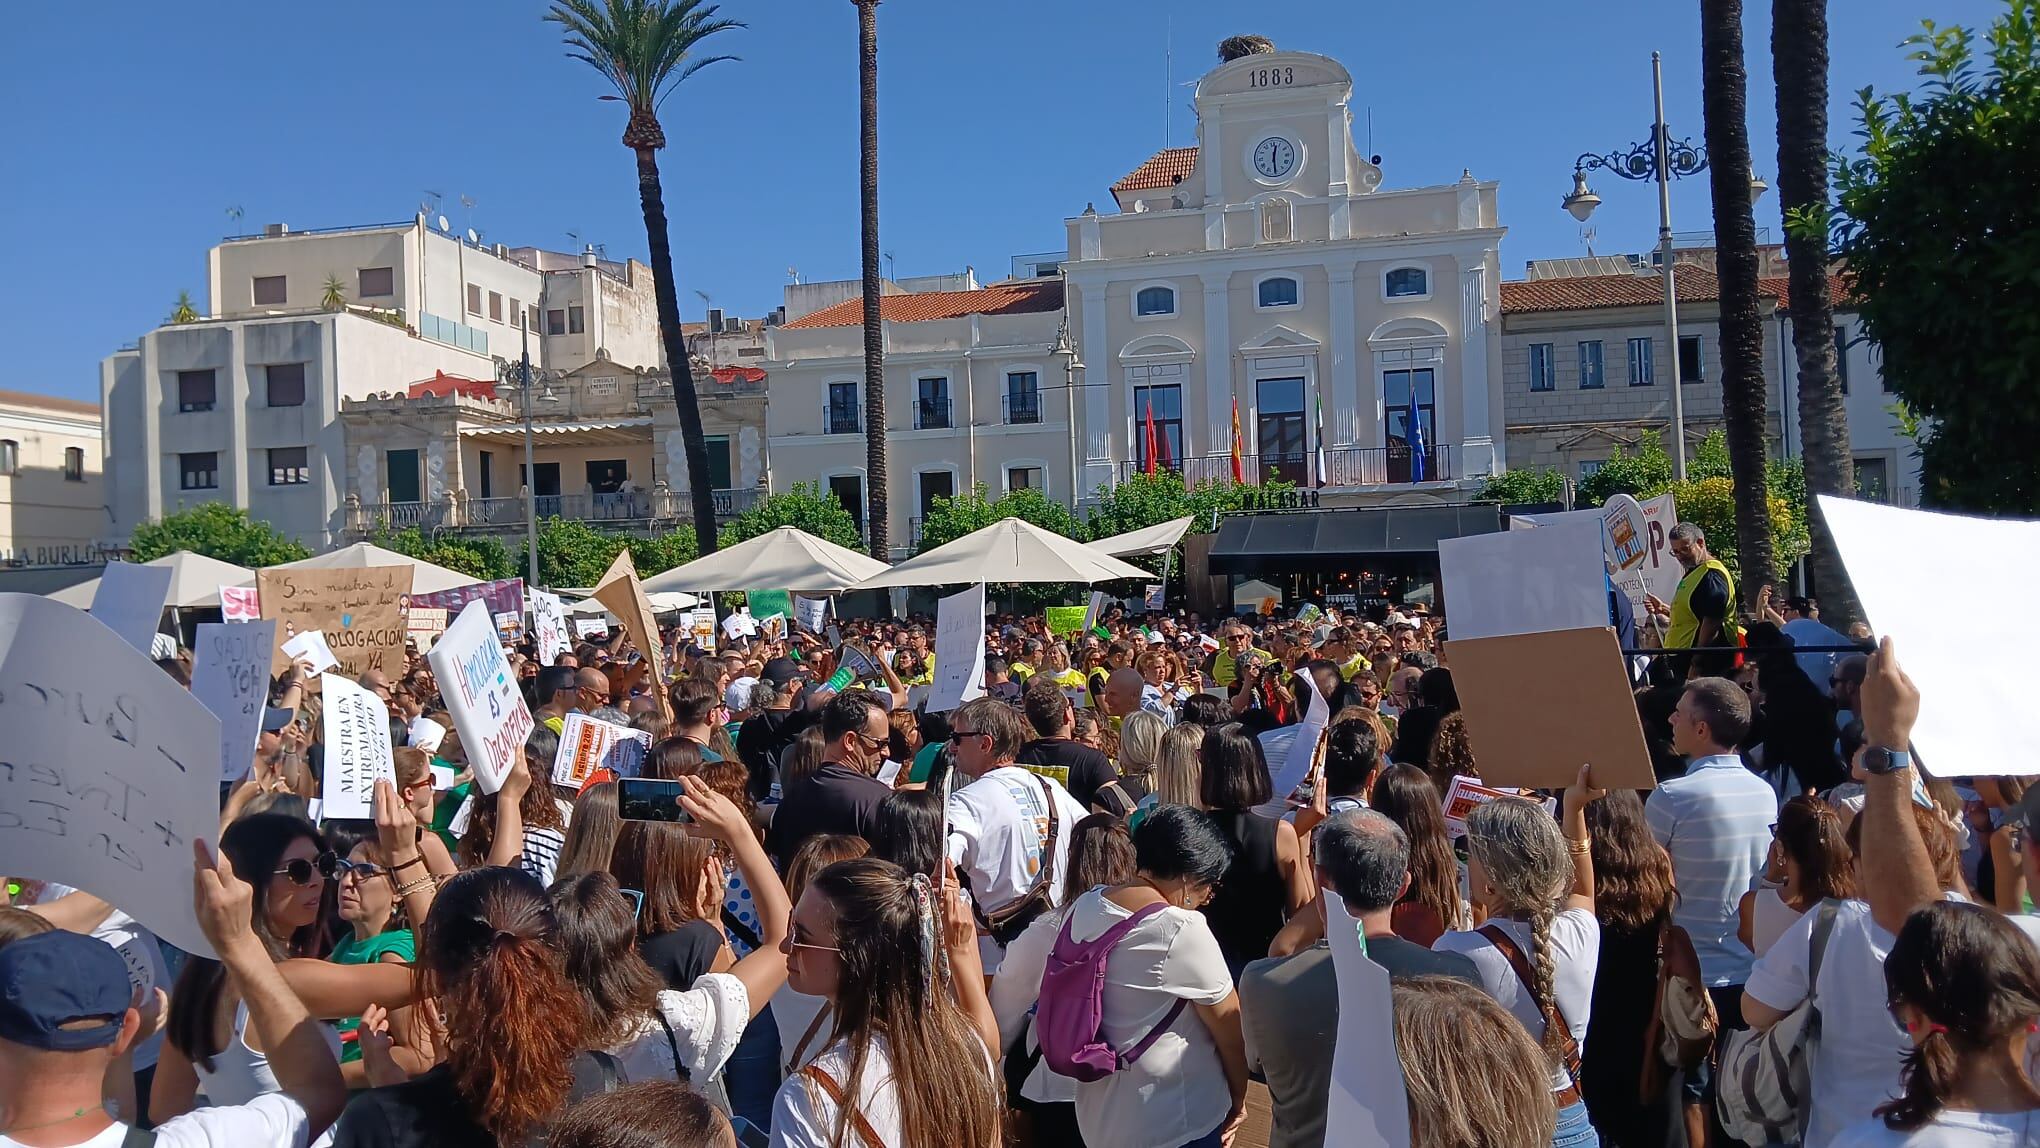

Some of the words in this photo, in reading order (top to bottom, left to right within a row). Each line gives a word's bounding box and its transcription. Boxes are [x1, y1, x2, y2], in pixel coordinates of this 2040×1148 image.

[1249, 67, 1293, 88] 1883
[323, 626, 404, 649] OLOGACIÓN
[367, 649, 385, 673] YA
[338, 695, 350, 715] EN
[583, 723, 593, 744] 2025
[340, 719, 354, 793] MAESTRA
[353, 693, 372, 804] EXTREMADURA
